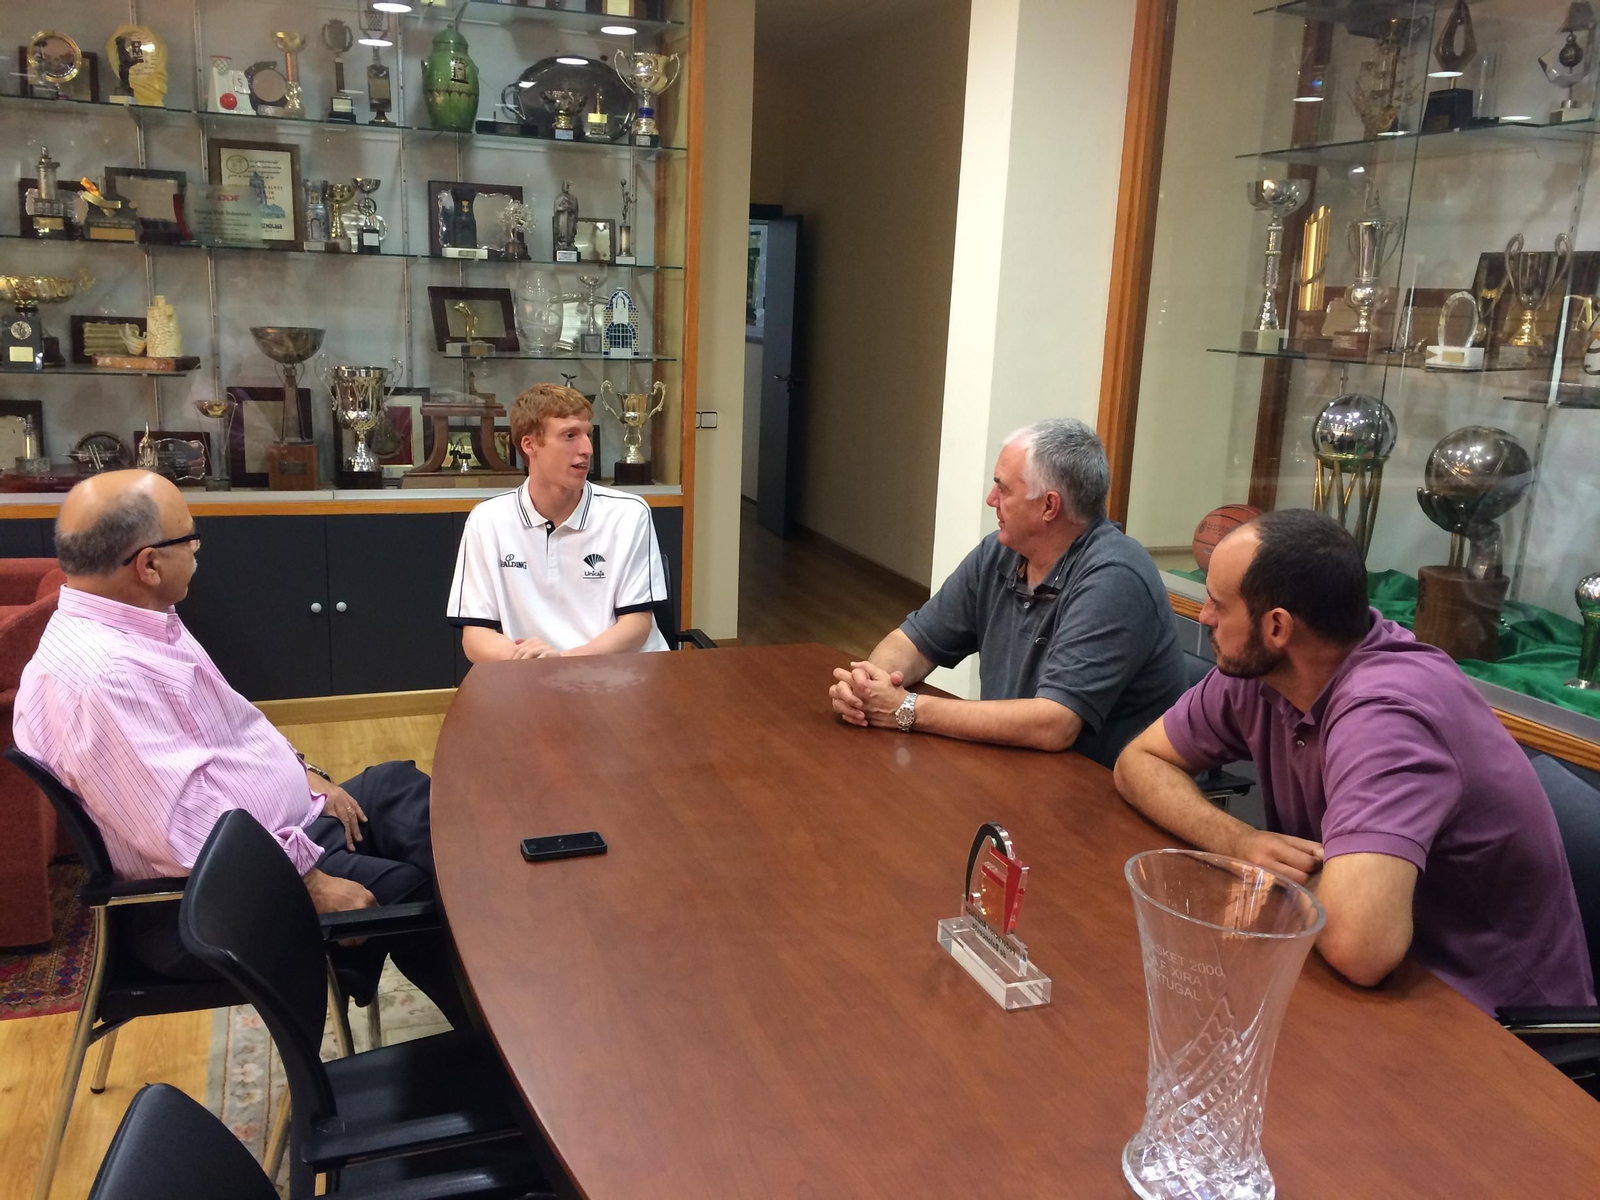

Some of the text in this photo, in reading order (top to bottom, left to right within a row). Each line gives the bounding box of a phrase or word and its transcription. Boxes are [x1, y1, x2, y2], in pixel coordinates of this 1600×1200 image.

[500, 560, 527, 570] PALDING
[584, 570, 605, 578] Unicaja
[1190, 959, 1224, 977] 2000
[1171, 965, 1203, 987] XIRA
